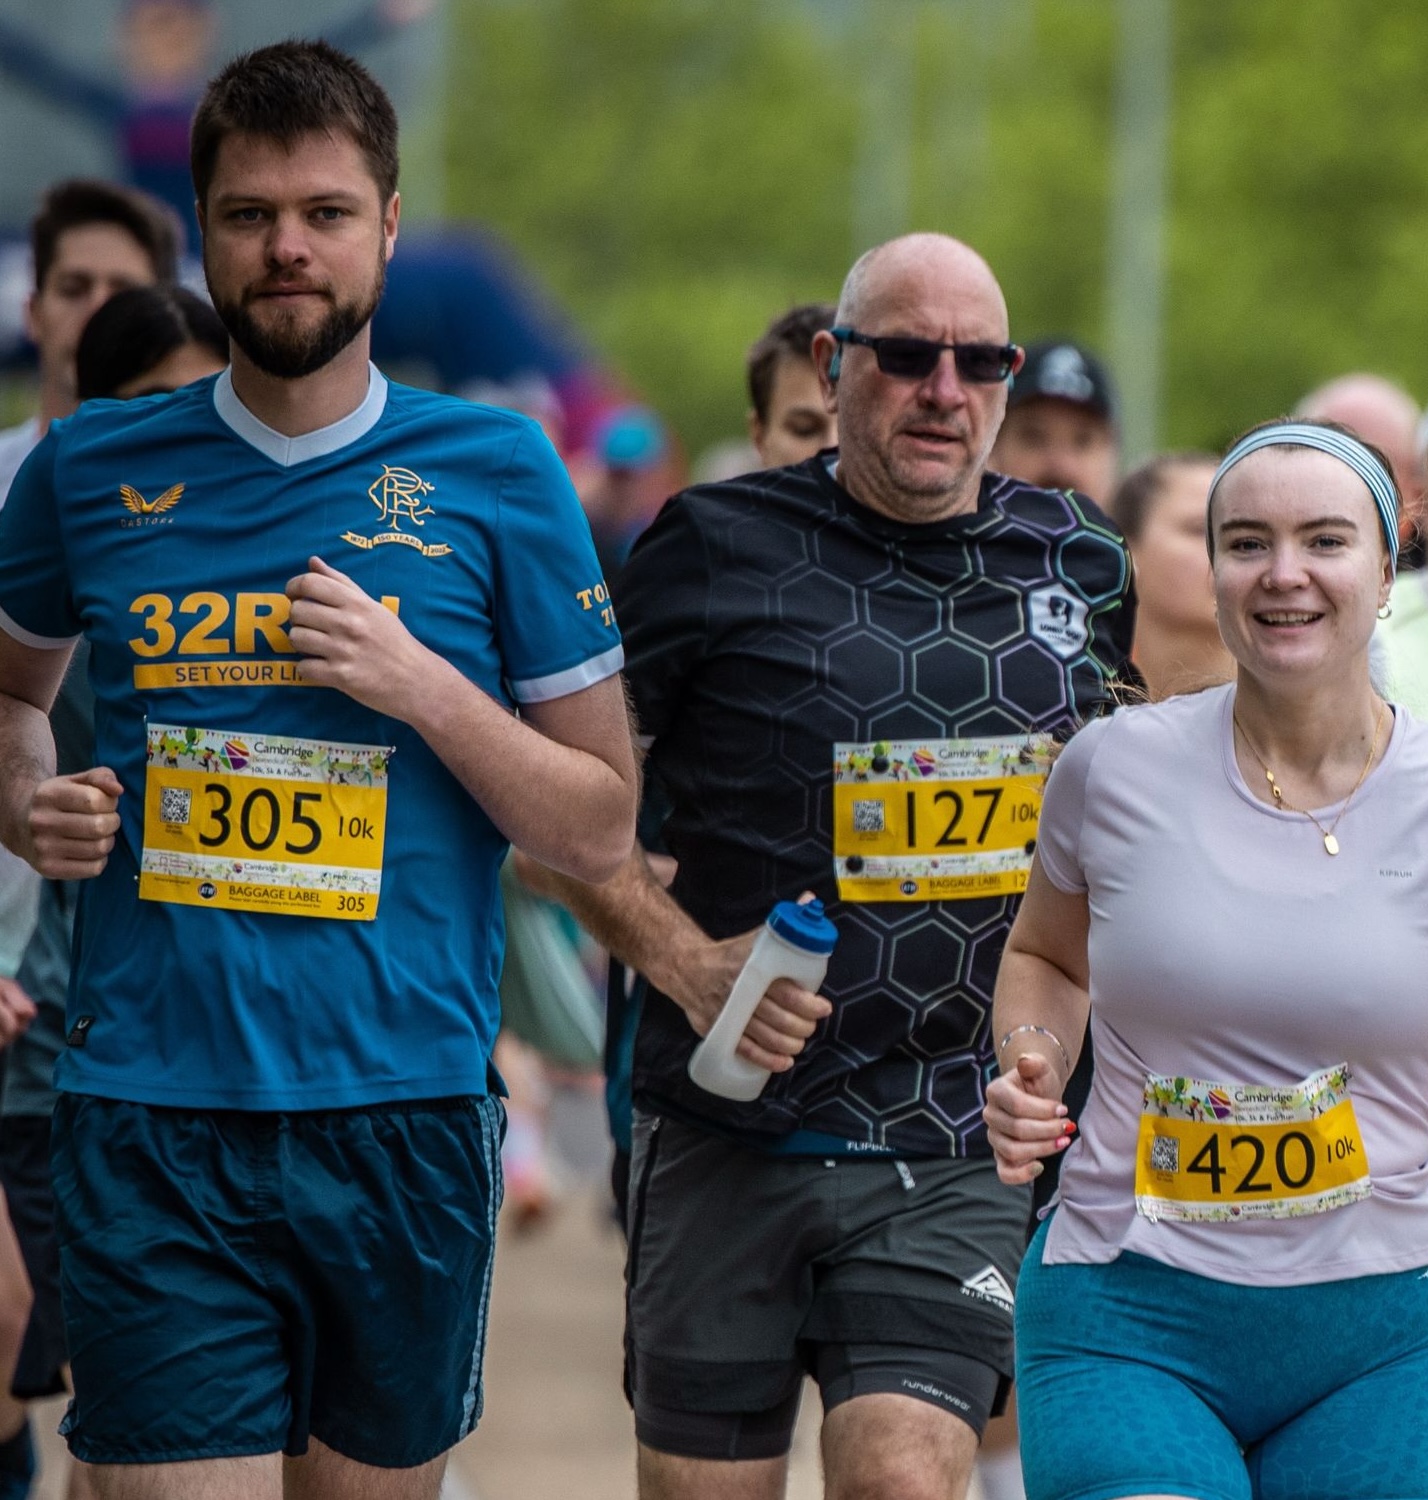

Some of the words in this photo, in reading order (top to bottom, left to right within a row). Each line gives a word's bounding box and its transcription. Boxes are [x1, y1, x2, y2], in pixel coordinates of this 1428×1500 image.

[393, 534, 420, 546] YEARS
[175, 666, 210, 682] SET
[216, 664, 274, 681] YOUR
[281, 664, 302, 681] LI
[254, 742, 313, 758] Cambridge
[199, 783, 322, 854] 305
[338, 816, 374, 840] 10k
[906, 788, 1004, 848] 127
[229, 885, 285, 899] BAGGAGE
[288, 890, 322, 903] LABEL
[337, 895, 366, 912] 305
[1235, 1091, 1293, 1106] Cambridge
[1186, 1131, 1316, 1194] 420
[1327, 1136, 1356, 1163] 10k
[903, 1379, 971, 1411] runderwear
